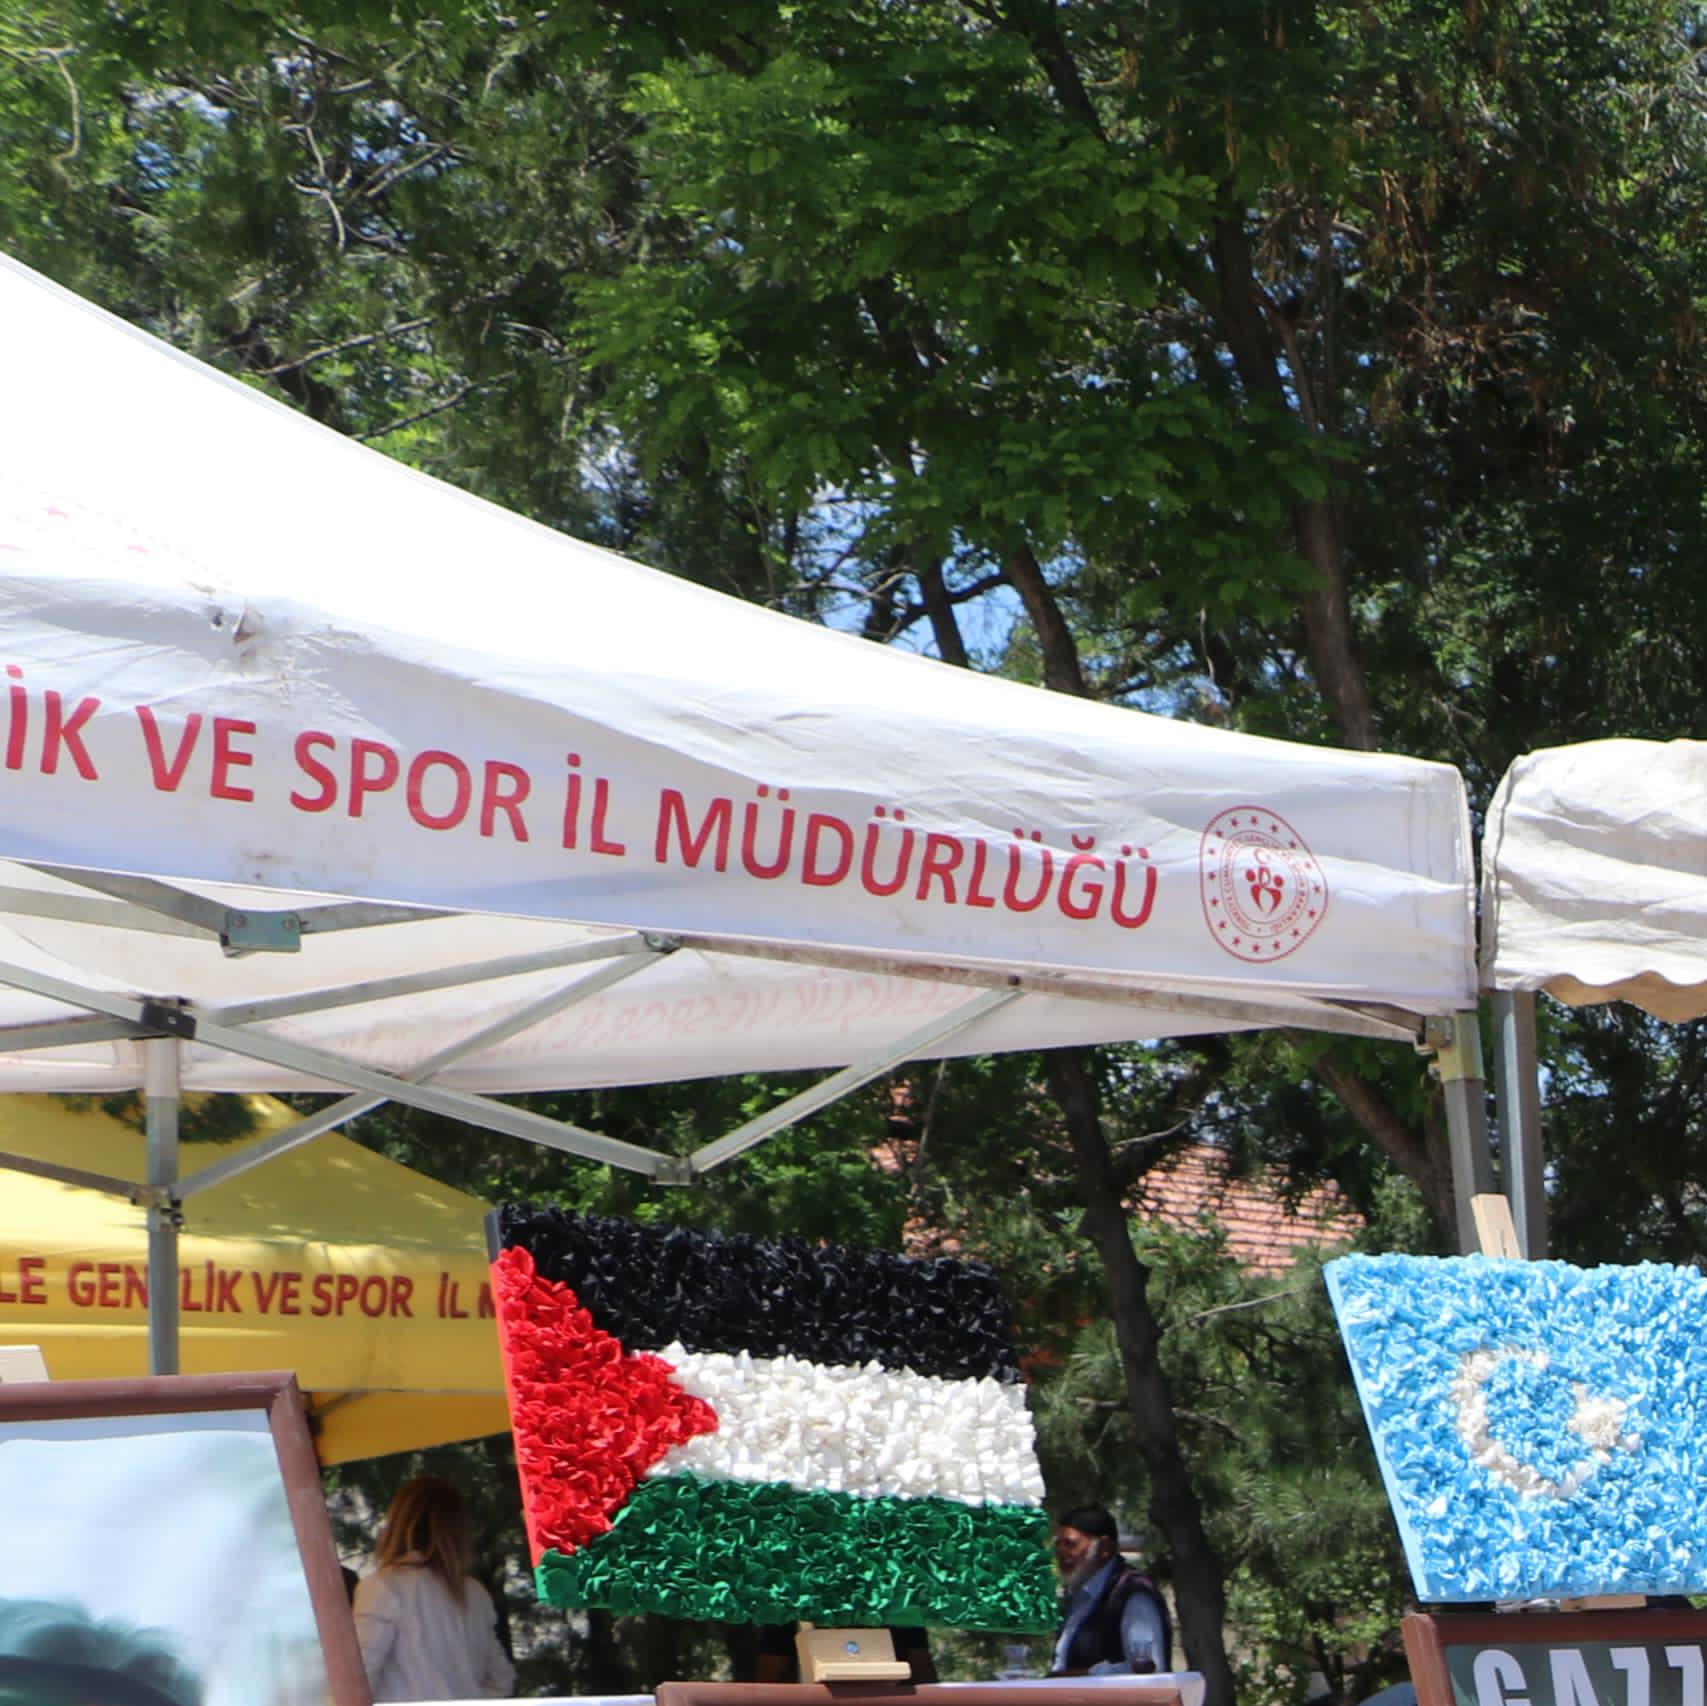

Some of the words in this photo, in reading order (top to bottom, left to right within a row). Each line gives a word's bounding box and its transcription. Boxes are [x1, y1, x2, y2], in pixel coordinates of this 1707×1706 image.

[5, 664, 102, 780] İK
[134, 705, 257, 803] VE
[289, 730, 532, 843] SPOR
[562, 752, 626, 857] İL
[655, 783, 1158, 930] MÜDÜRLÜĞÜ
[67, 1260, 243, 1313] GENLİK
[251, 1271, 302, 1315] VE
[310, 1274, 414, 1318] SPOR
[437, 1271, 468, 1319] İL
